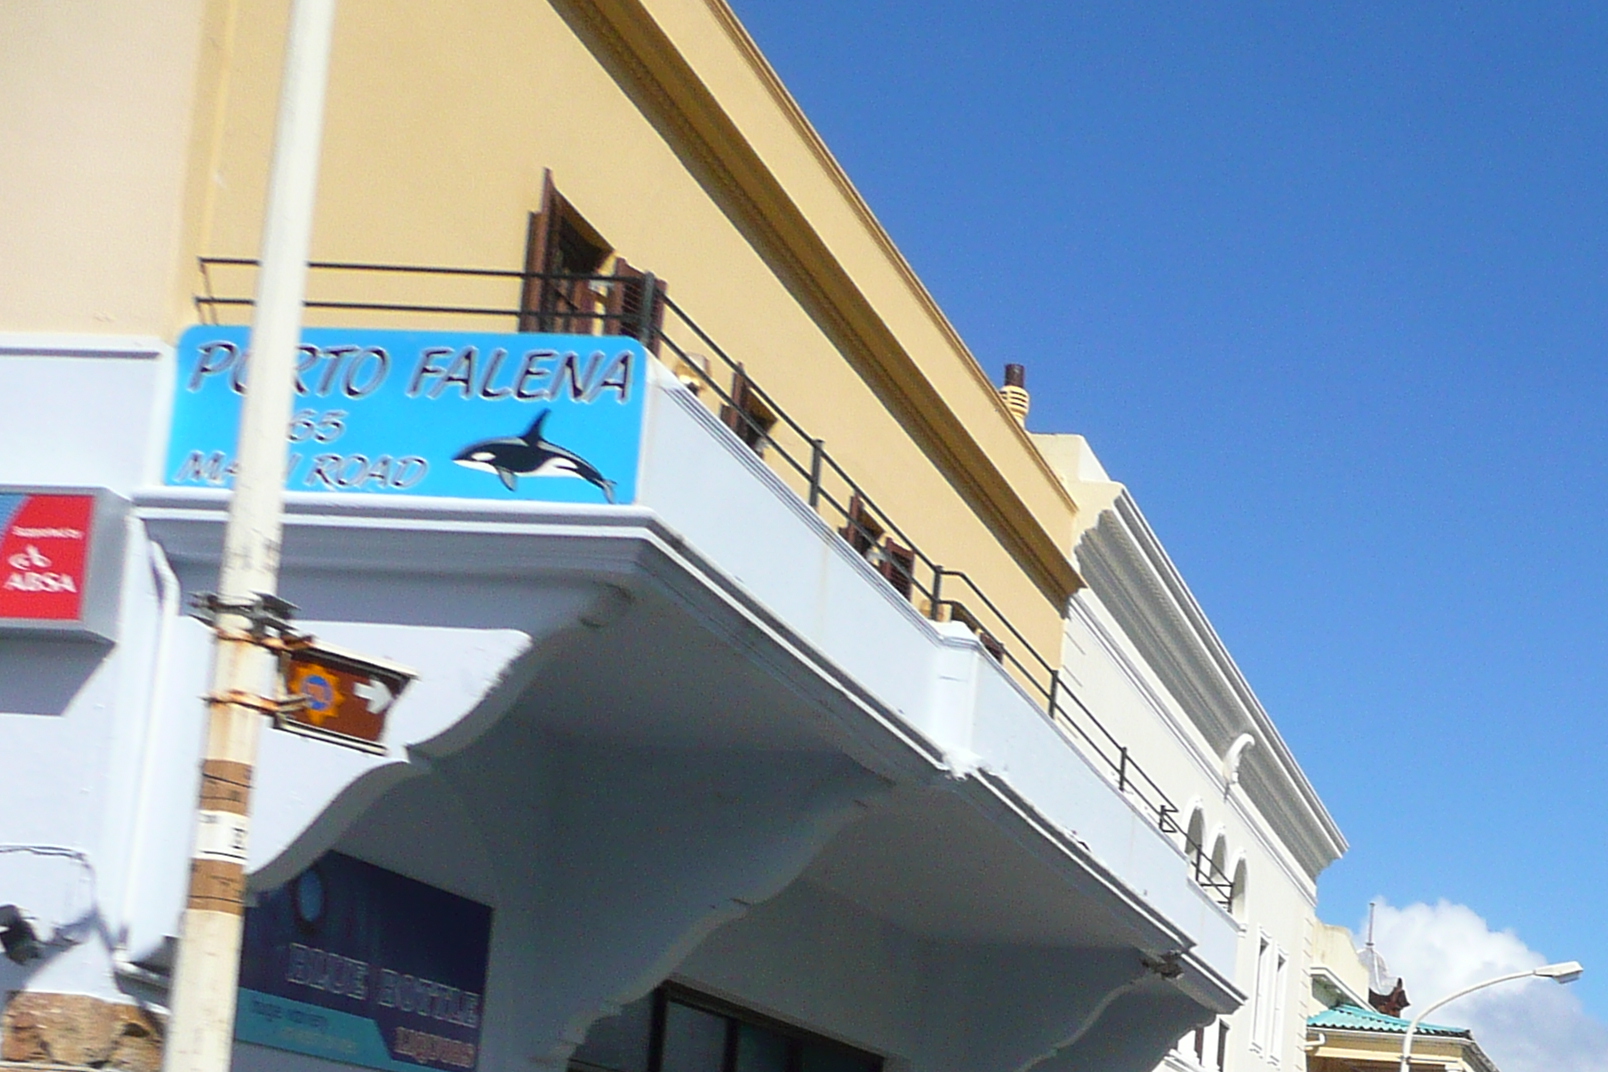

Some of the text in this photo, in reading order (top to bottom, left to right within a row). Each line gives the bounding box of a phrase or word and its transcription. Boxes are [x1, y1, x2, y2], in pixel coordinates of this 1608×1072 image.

[406, 345, 634, 404] FALENA
[304, 453, 429, 487] ROAD
[3, 571, 78, 593] ABSA
